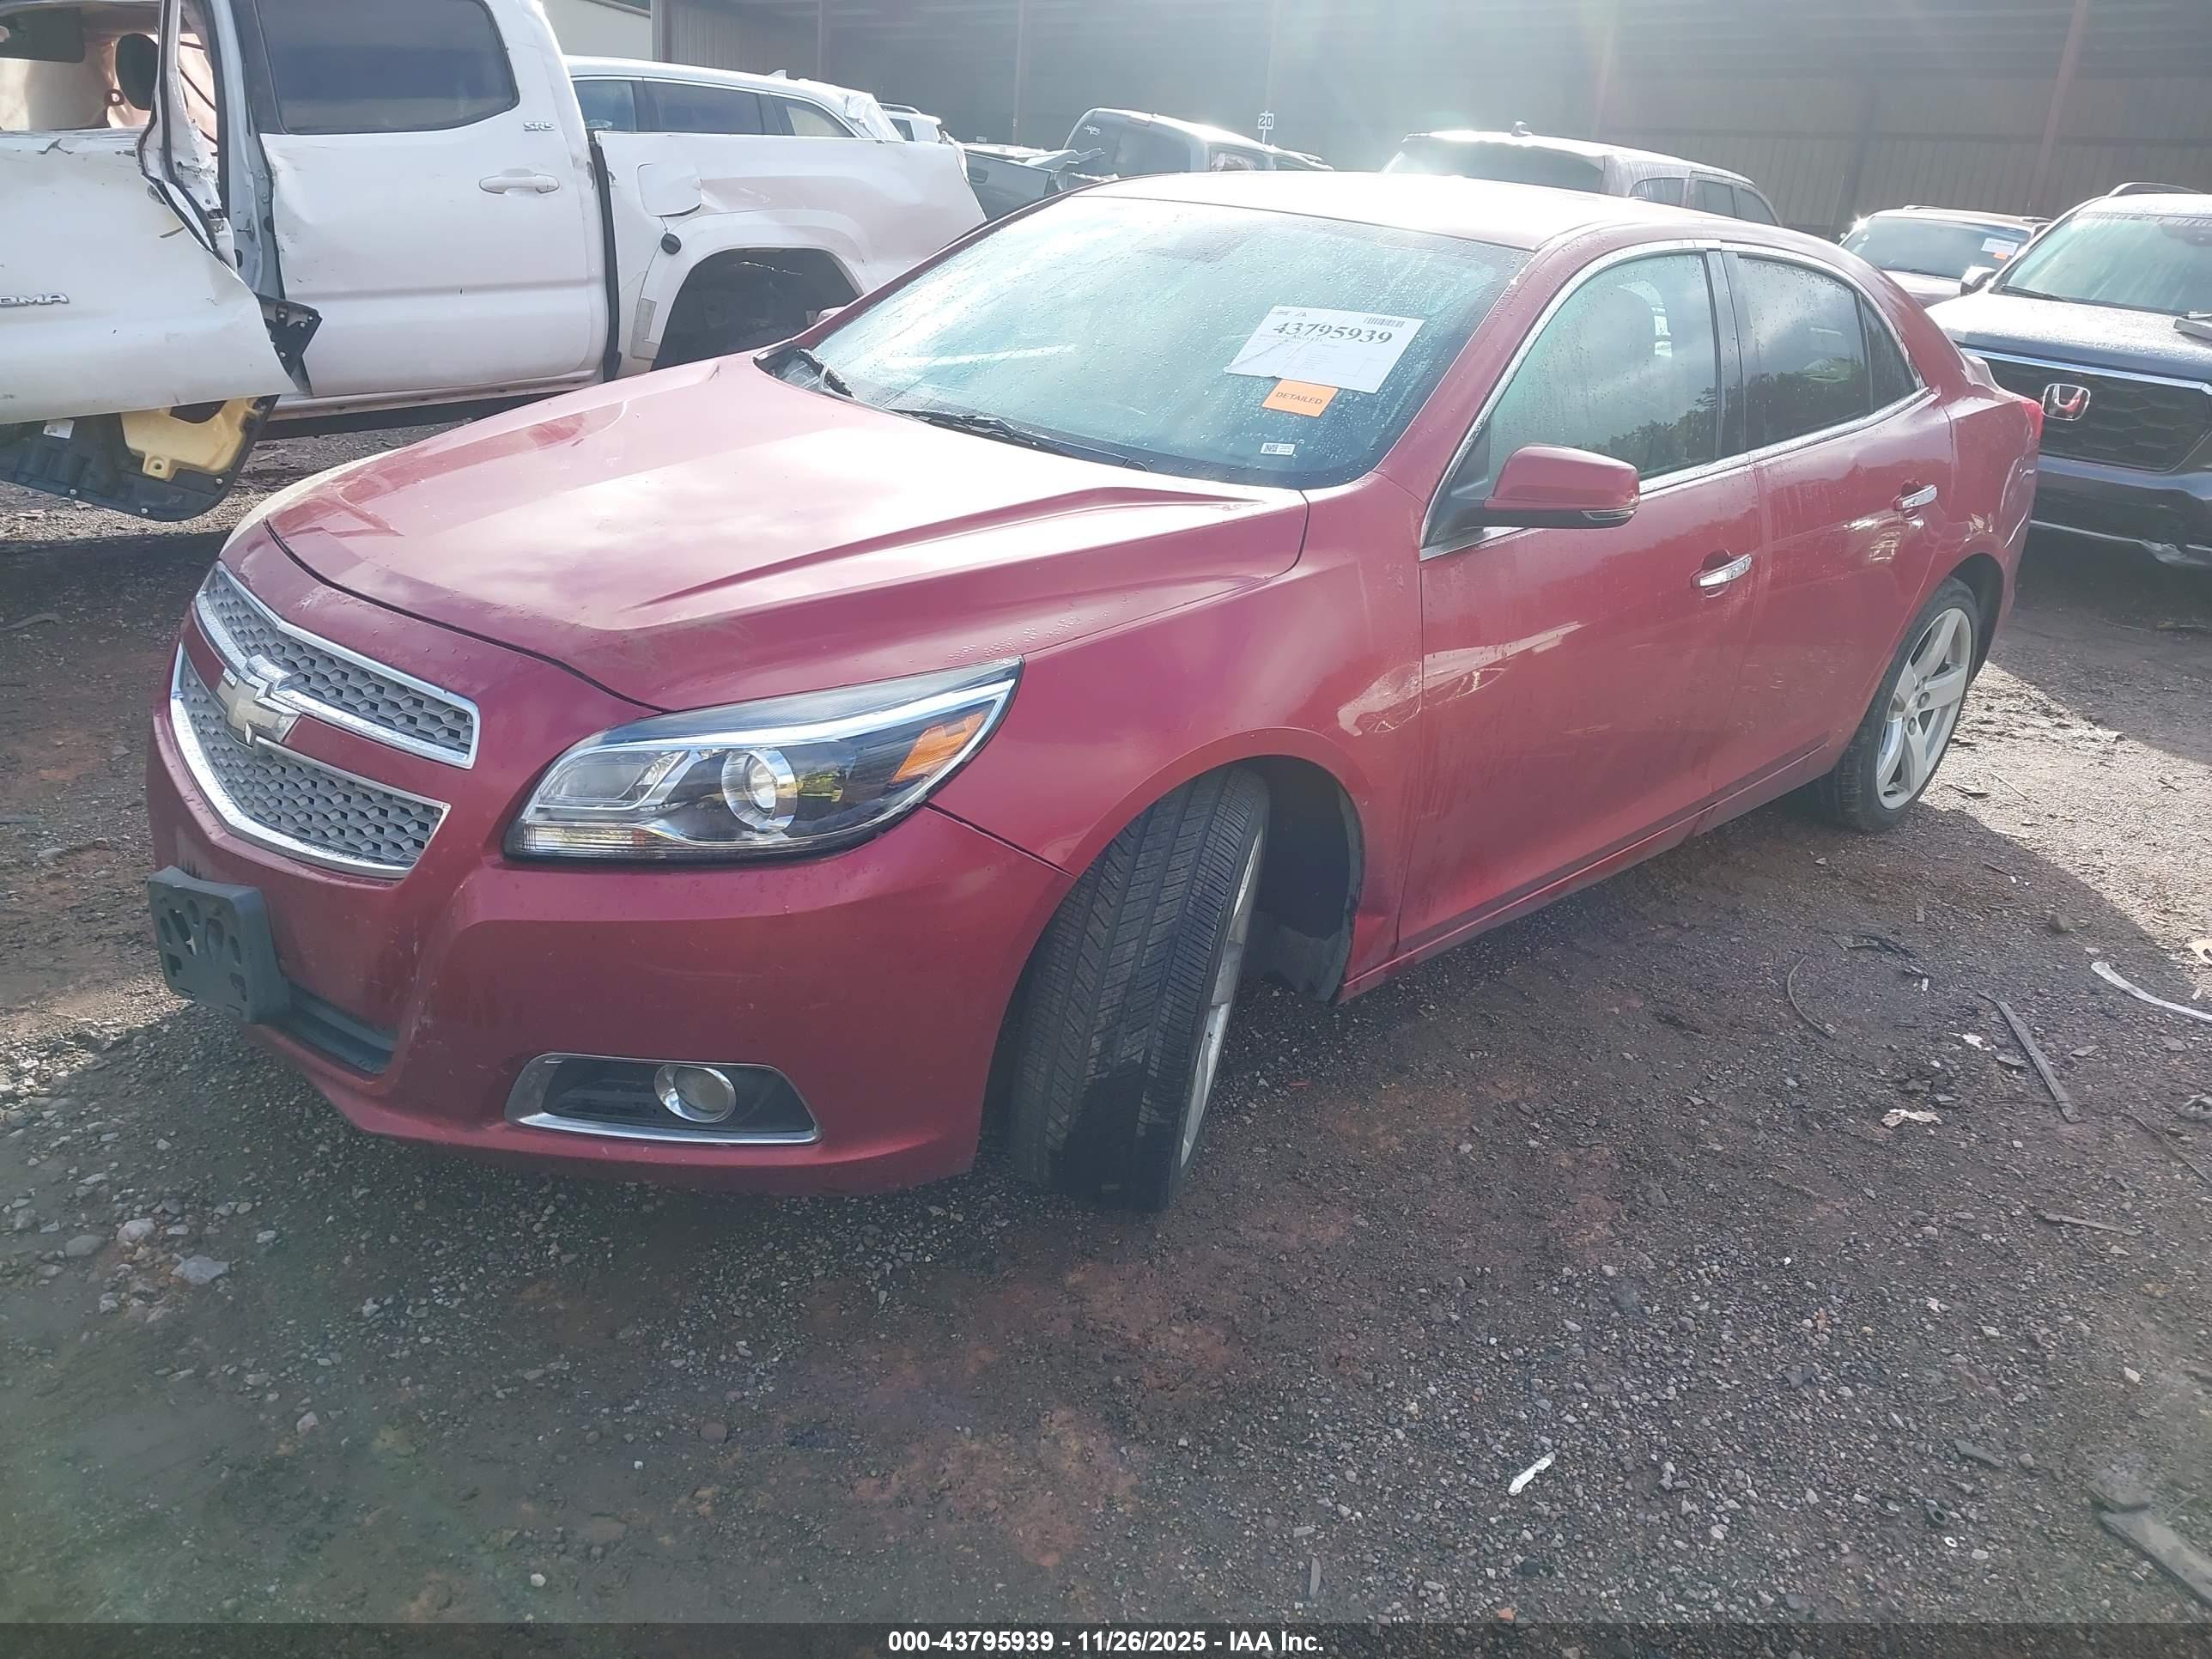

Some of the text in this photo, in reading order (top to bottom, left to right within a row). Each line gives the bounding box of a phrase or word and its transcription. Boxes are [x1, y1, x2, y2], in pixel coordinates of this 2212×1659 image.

[1259, 115, 1273, 127] 20
[1273, 321, 1394, 344] 43795939
[1275, 391, 1323, 405] DETAILED
